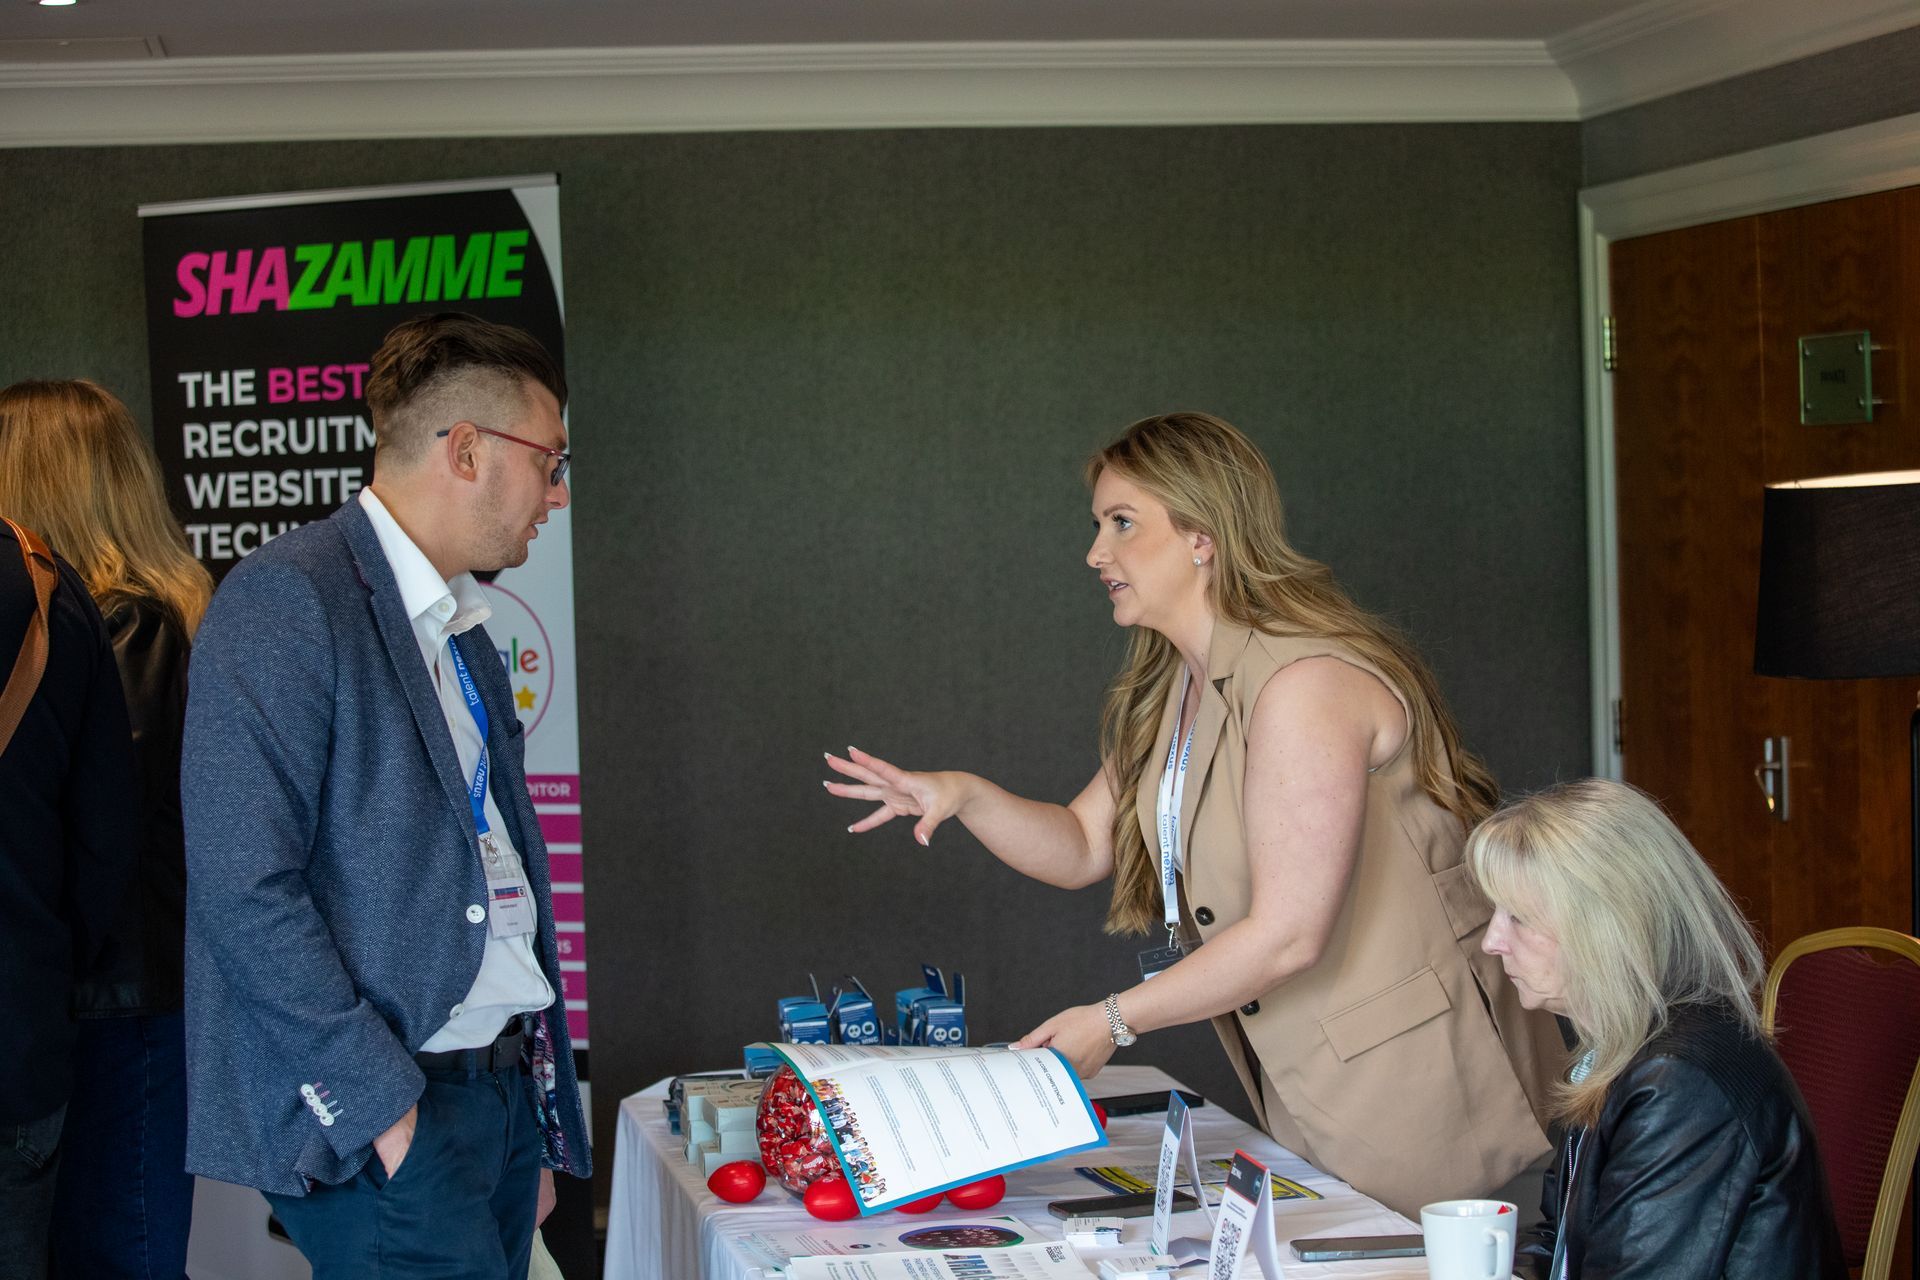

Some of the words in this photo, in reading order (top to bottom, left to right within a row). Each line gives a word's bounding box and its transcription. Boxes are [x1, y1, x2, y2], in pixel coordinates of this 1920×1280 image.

[173, 229, 529, 318] SHAZAMME
[178, 370, 256, 408] THE
[268, 363, 370, 404] BEST
[459, 672, 480, 706] talent
[473, 767, 486, 798] nexus
[1039, 1063, 1049, 1074] CORE
[1045, 1072, 1066, 1106] COMPETENCIES
